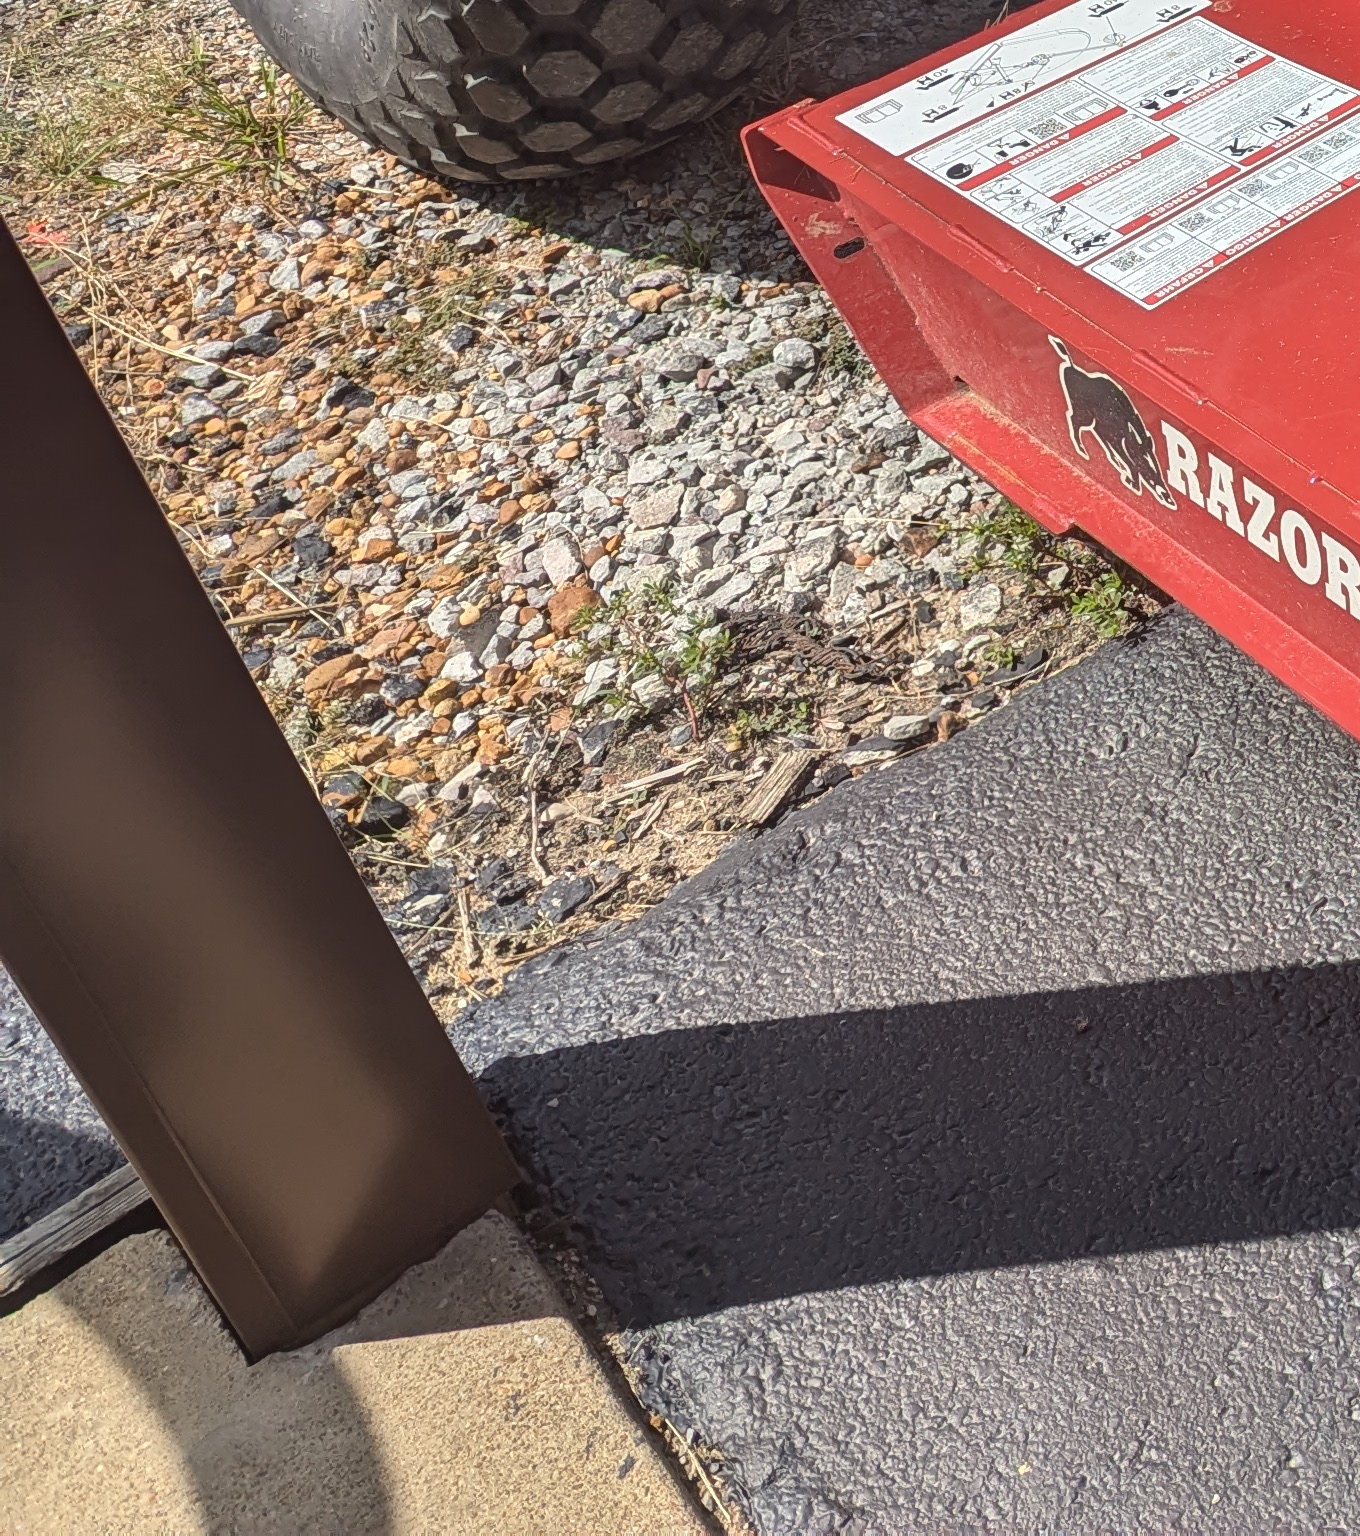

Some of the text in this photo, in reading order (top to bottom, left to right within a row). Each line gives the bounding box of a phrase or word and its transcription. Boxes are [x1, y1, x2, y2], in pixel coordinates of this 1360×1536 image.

[930, 67, 952, 78] 40
[1180, 78, 1229, 105] DANGER
[1270, 120, 1320, 149] DANGER
[1007, 138, 1060, 166] DANGER
[1079, 158, 1132, 187] DANGER
[1145, 188, 1198, 218] DANGER
[1281, 190, 1333, 221] DANGER
[1222, 226, 1272, 256] PERIGO
[1152, 266, 1205, 298] GEFAHR
